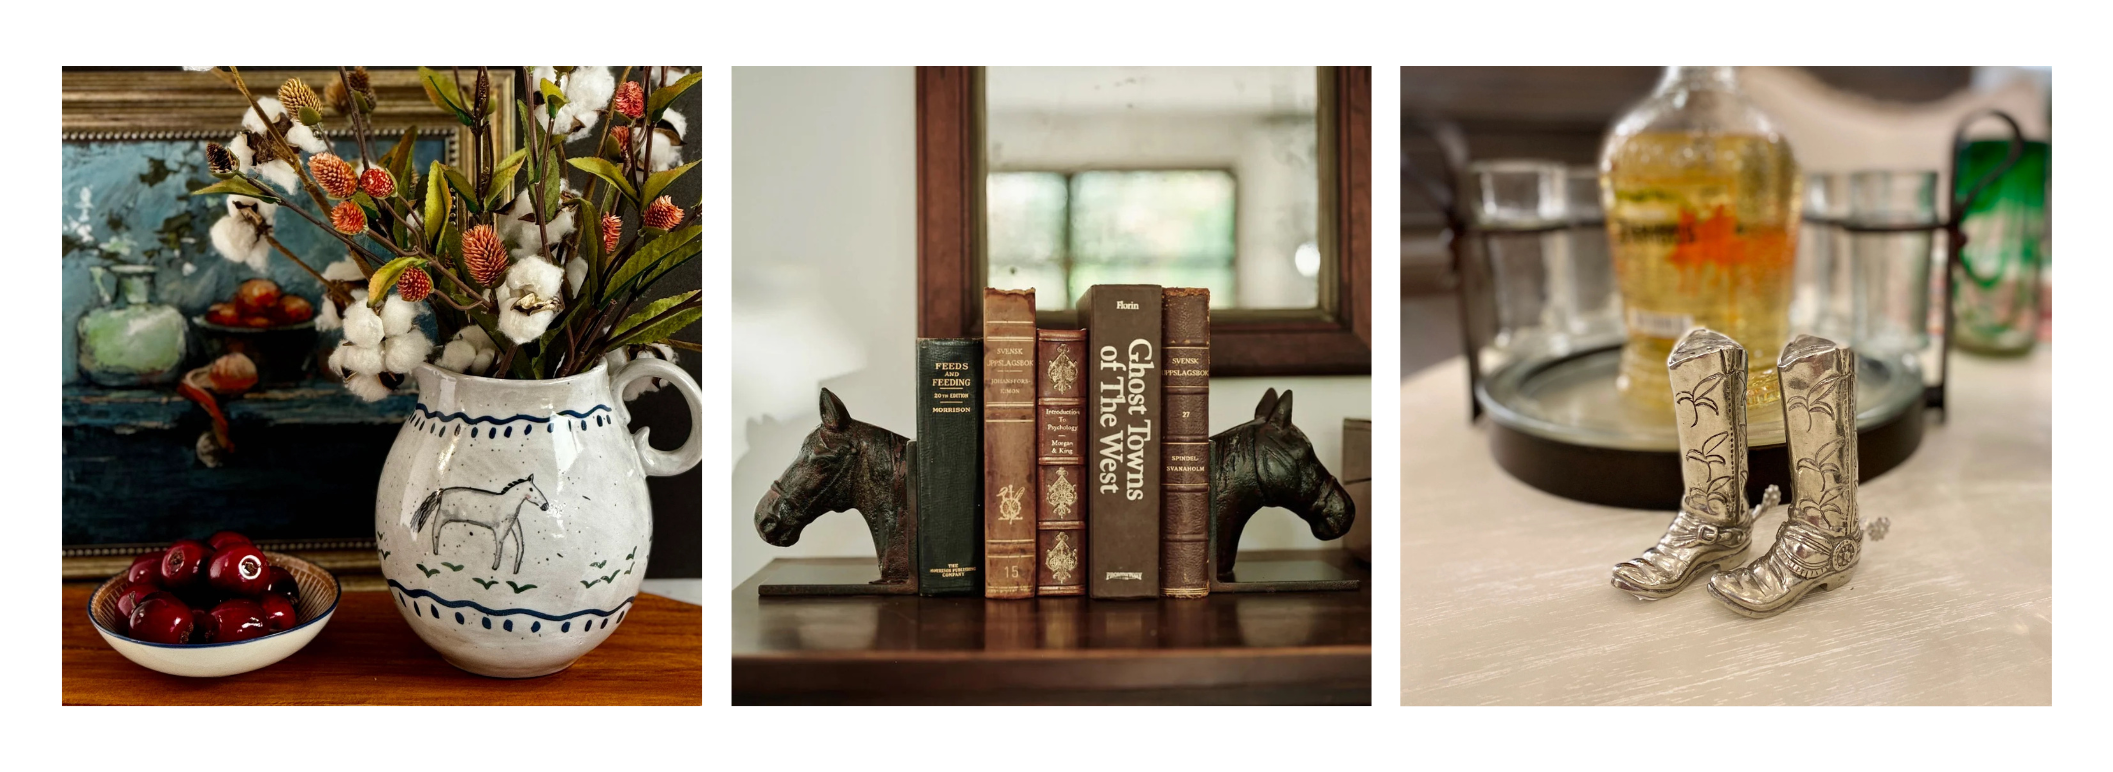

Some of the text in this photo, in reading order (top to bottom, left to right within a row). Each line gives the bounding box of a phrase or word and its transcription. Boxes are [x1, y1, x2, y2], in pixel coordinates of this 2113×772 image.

[1116, 300, 1140, 310] Florin
[932, 378, 971, 386] FEEDING
[1099, 345, 1127, 495] of The West
[1126, 338, 1155, 501] Ghost Towns
[1047, 424, 1078, 432] Psychology
[1004, 565, 1019, 578] 15
